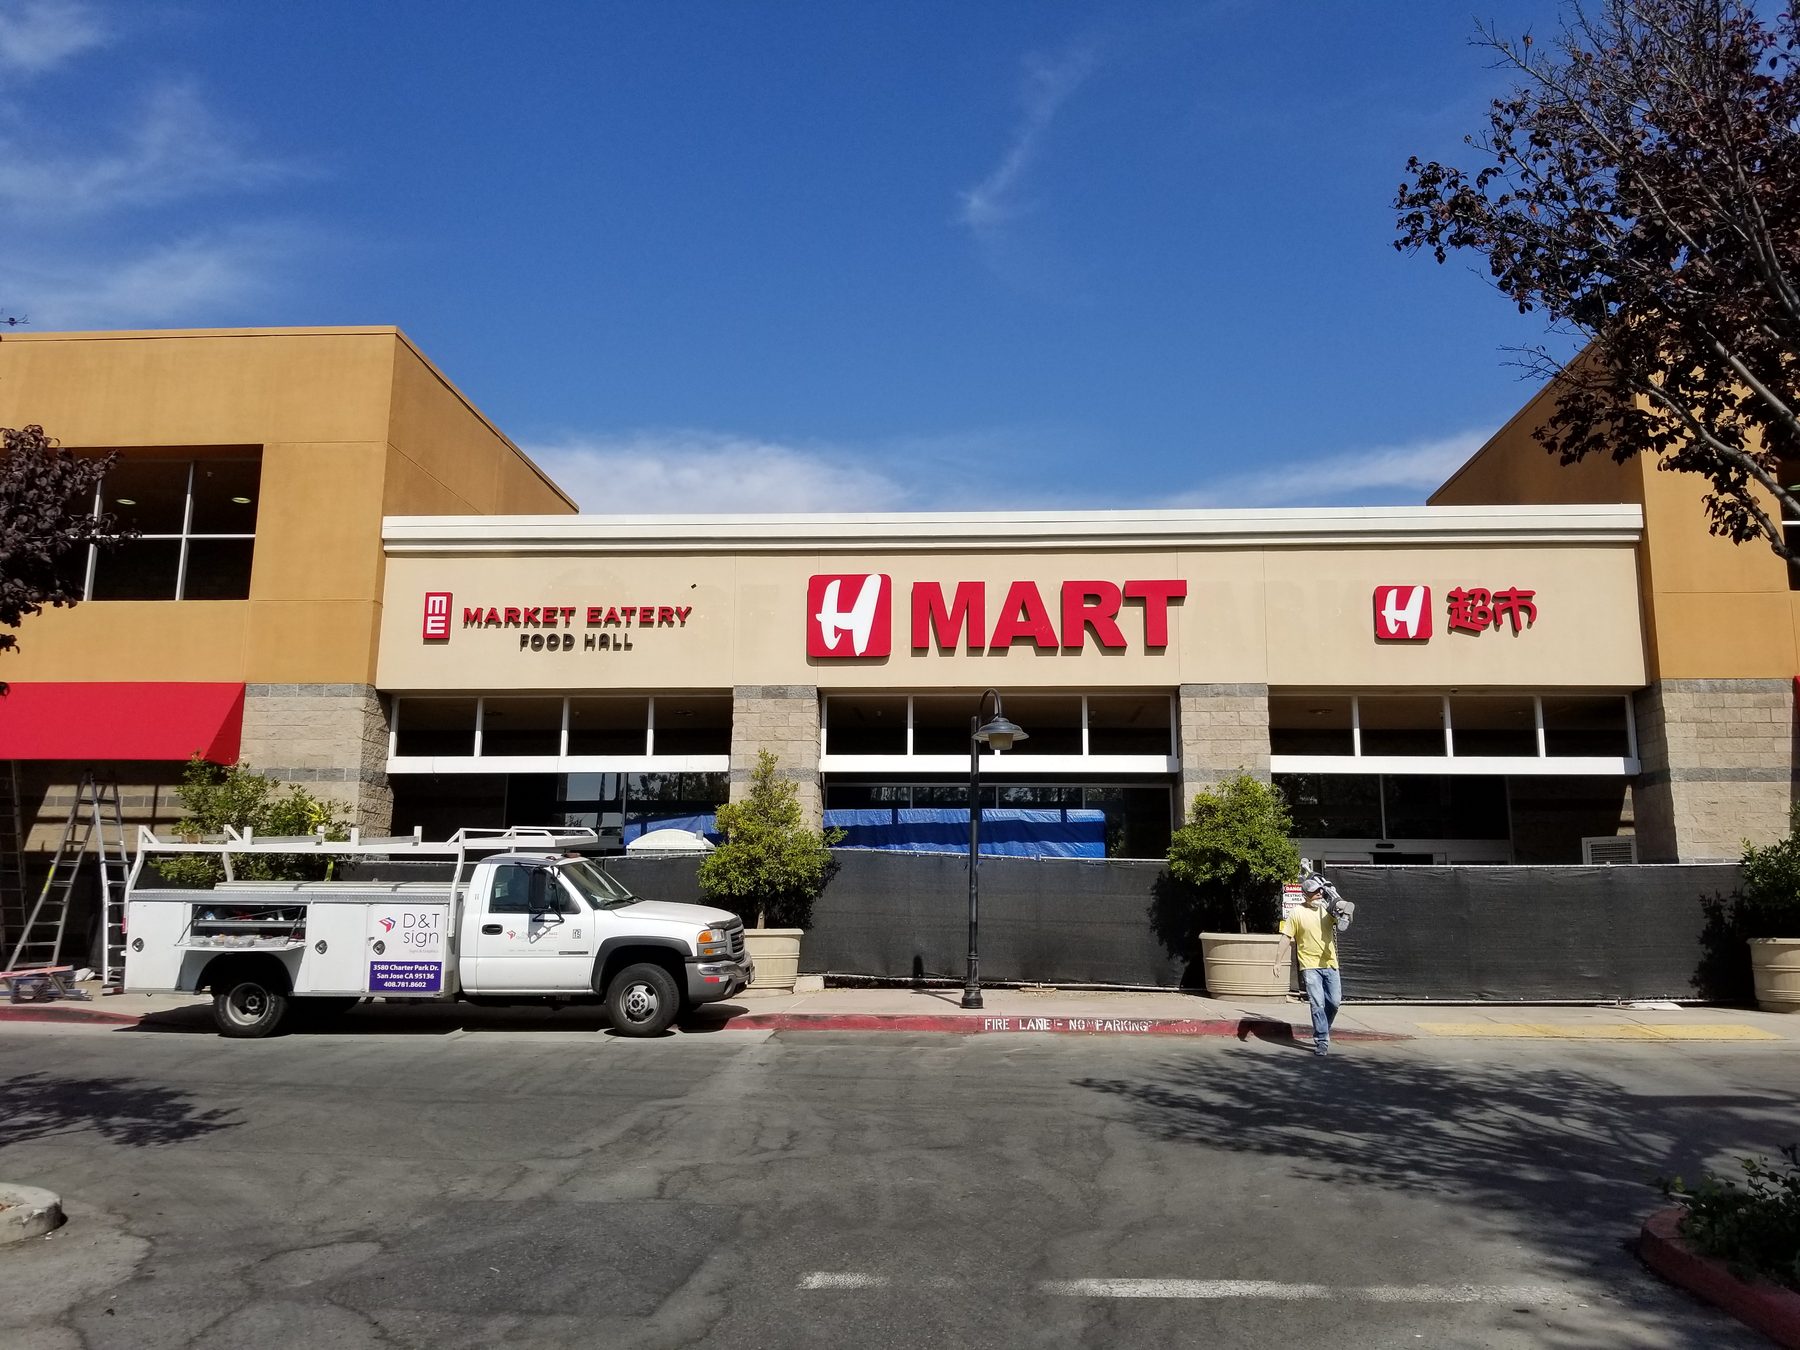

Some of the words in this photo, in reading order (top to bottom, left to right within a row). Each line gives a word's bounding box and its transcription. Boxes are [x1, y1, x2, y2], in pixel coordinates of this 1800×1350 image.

[463, 606, 577, 625] MARKET
[587, 606, 692, 624] EATERY
[815, 573, 882, 656] H
[912, 579, 1188, 649] MART
[1381, 585, 1425, 638] H
[1448, 586, 1537, 632] 超市
[520, 633, 575, 652] FOOD
[584, 632, 633, 652] HALL
[403, 913, 440, 929] D&T
[403, 930, 439, 948] sign
[984, 1018, 1010, 1031] FIRE
[1019, 1017, 1051, 1031] LANE
[1069, 1018, 1086, 1031] NO
[1095, 1018, 1149, 1032] PARKING
